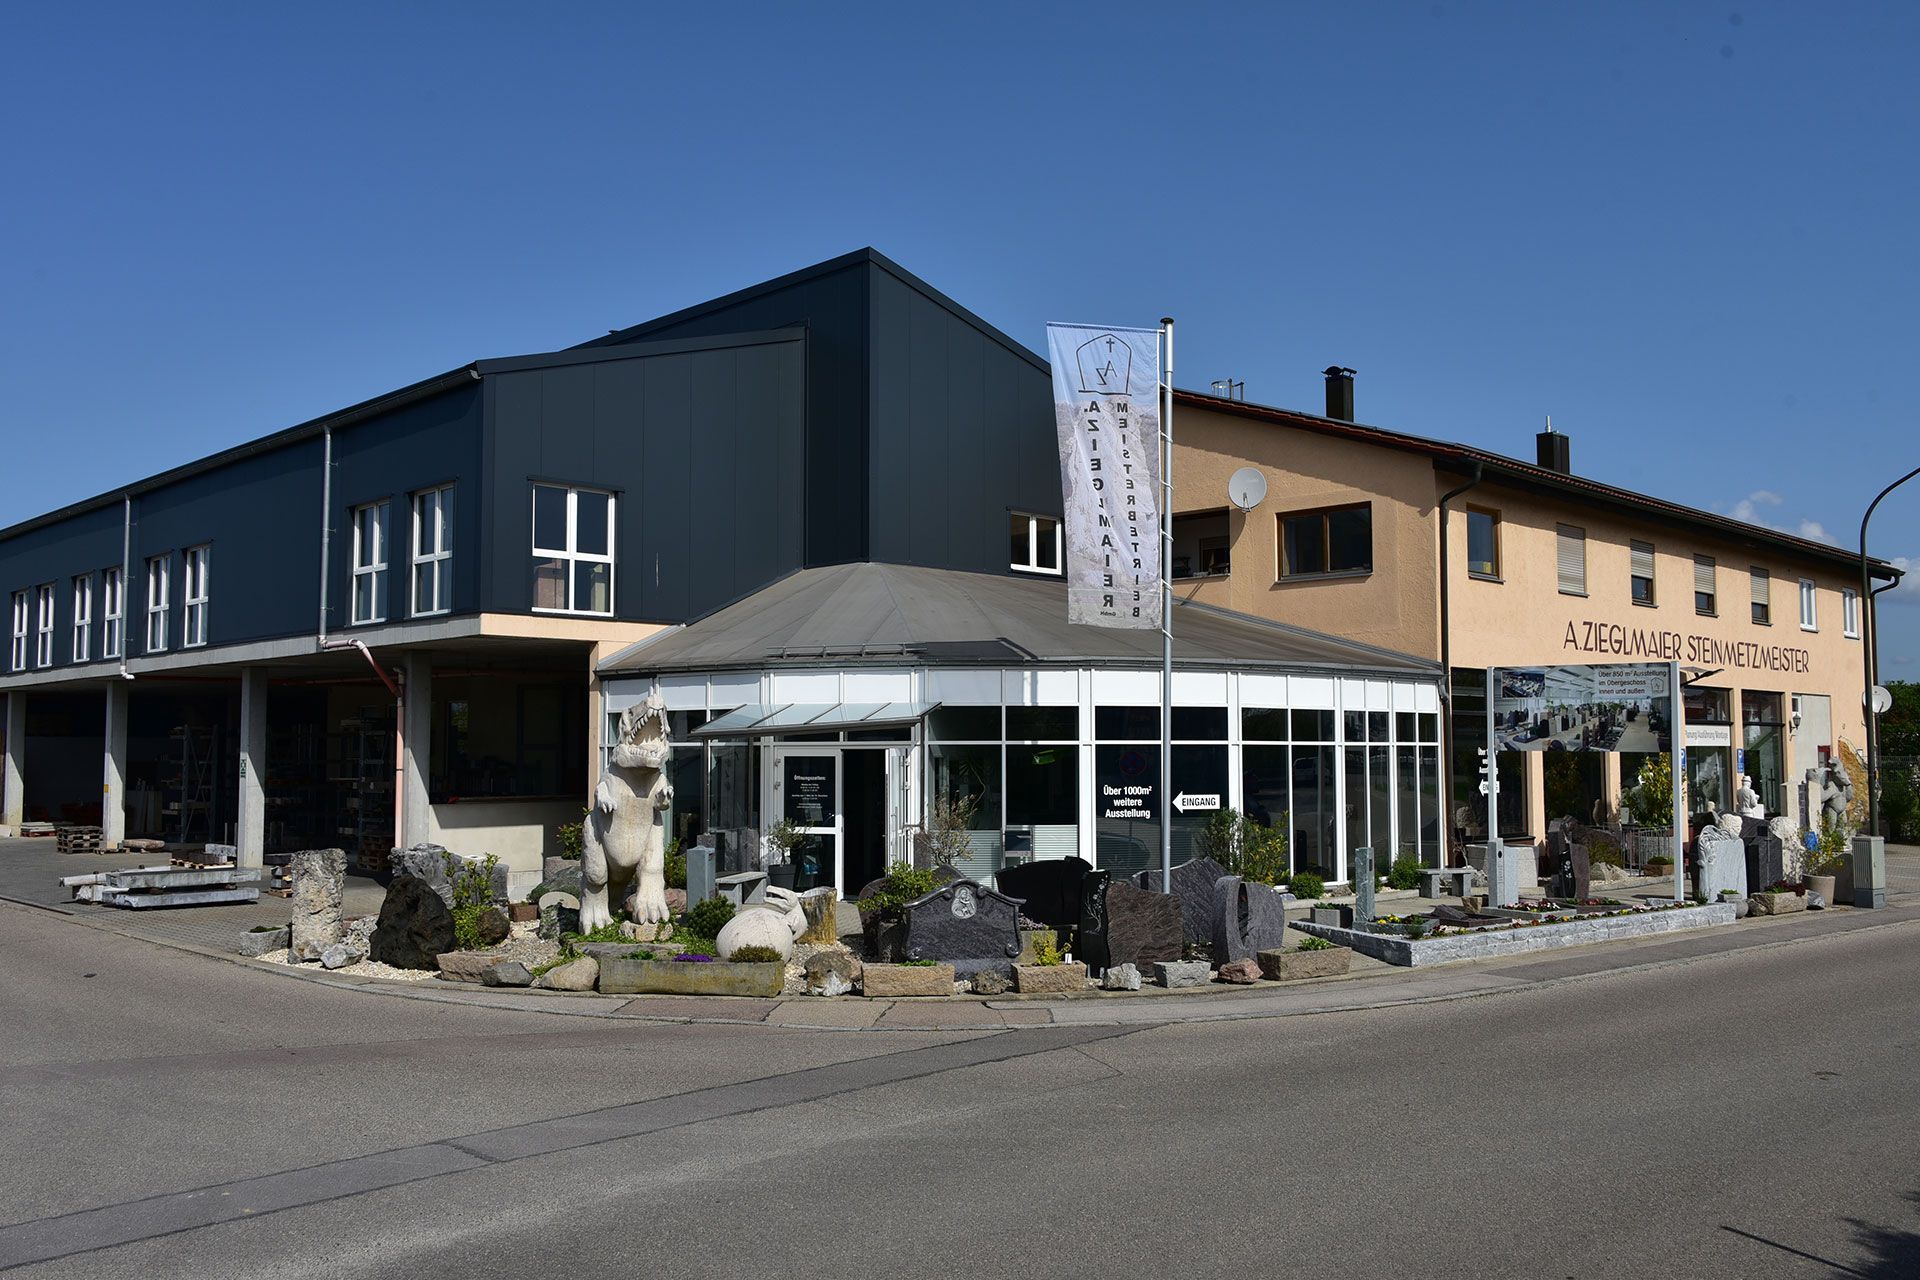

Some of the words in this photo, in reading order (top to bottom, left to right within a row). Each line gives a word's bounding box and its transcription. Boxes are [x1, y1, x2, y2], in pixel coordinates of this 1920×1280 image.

[1687, 635, 1809, 673] STEINMETZMEISTER
[1633, 670, 1667, 678] Ausstellung
[1607, 679, 1647, 687] Obergeschoss
[1103, 785, 1122, 795] Über
[1124, 786, 1152, 795] 1000m²
[1113, 798, 1142, 806] weitere
[1182, 798, 1216, 806] EINGANG
[1105, 809, 1150, 819] Ausstellung
